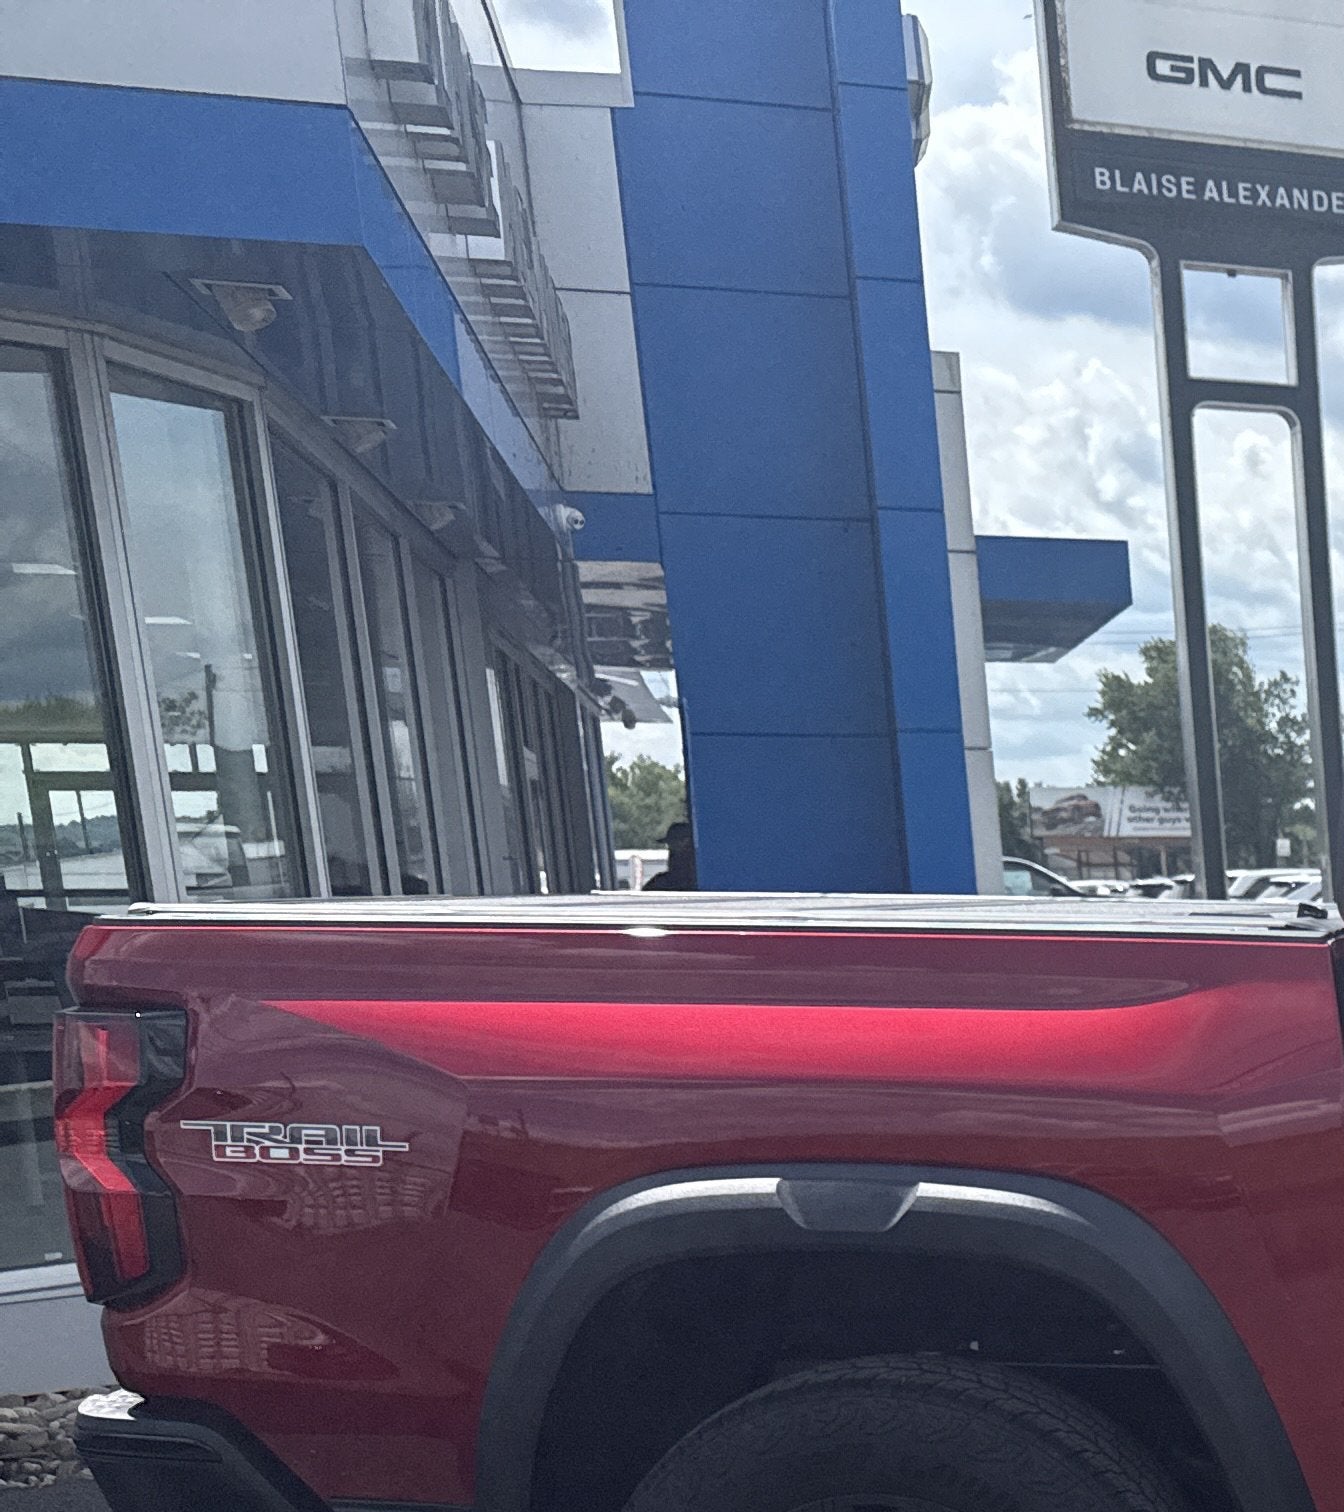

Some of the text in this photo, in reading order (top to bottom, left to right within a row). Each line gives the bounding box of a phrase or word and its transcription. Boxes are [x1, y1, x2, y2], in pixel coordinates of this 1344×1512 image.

[1146, 50, 1302, 100] GMC
[1094, 167, 1196, 200] BLAISE
[180, 1119, 410, 1151] TRAIL
[211, 1142, 383, 1167] BOSS
